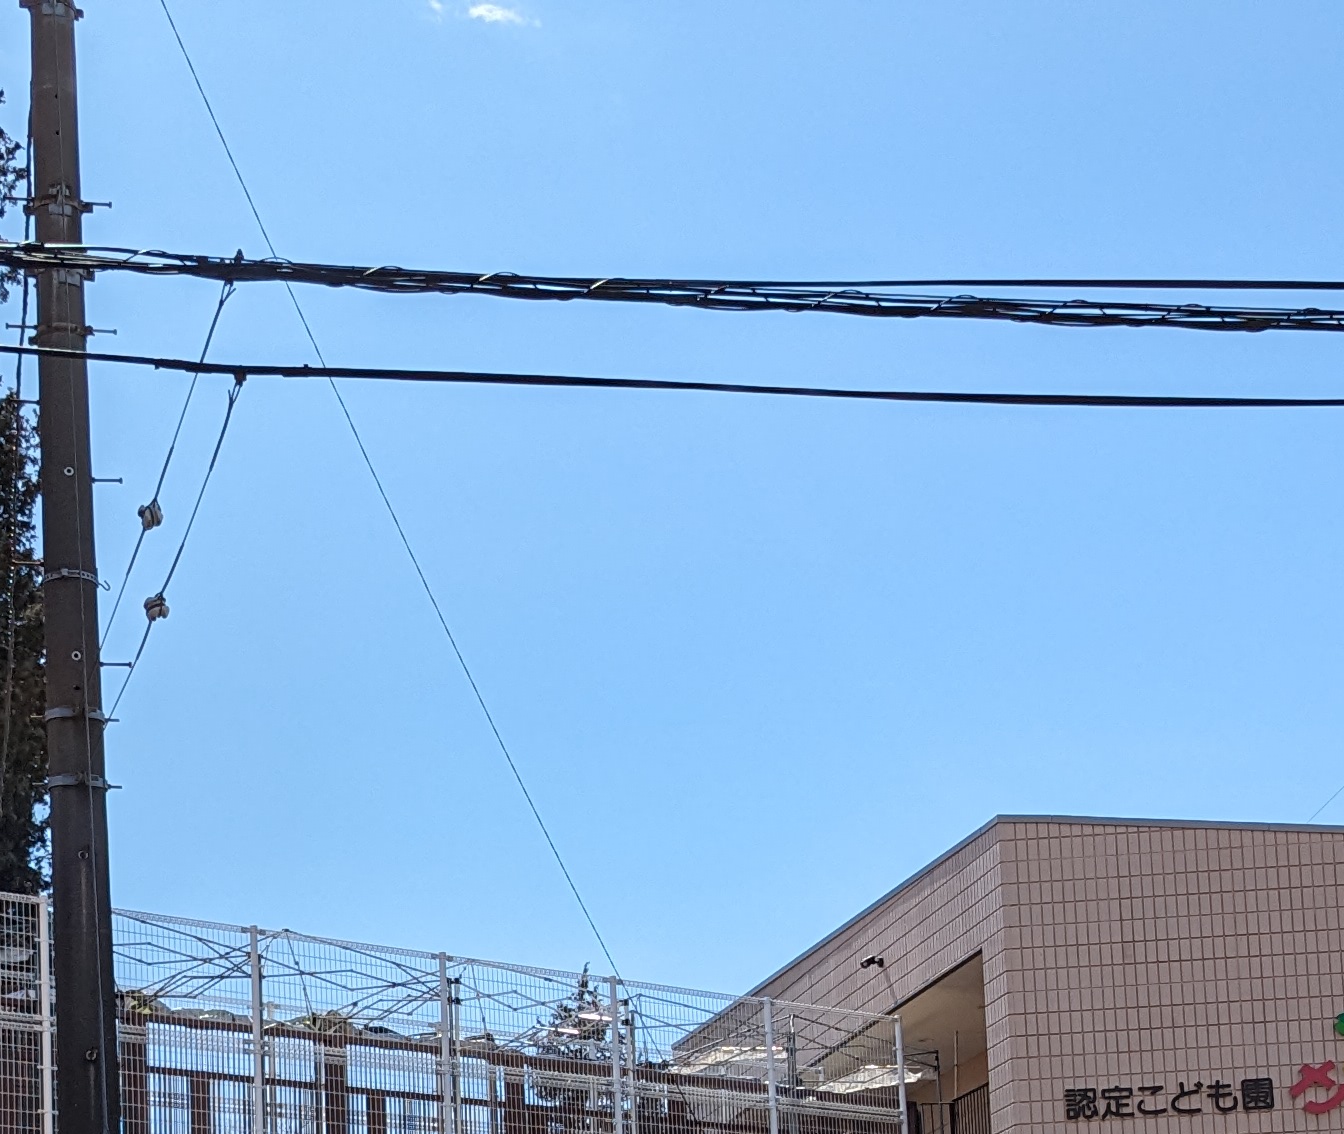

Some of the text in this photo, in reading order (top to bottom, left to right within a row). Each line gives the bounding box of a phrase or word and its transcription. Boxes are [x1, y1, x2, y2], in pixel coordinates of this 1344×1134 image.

[1064, 1077, 1274, 1121] 認定こども園
